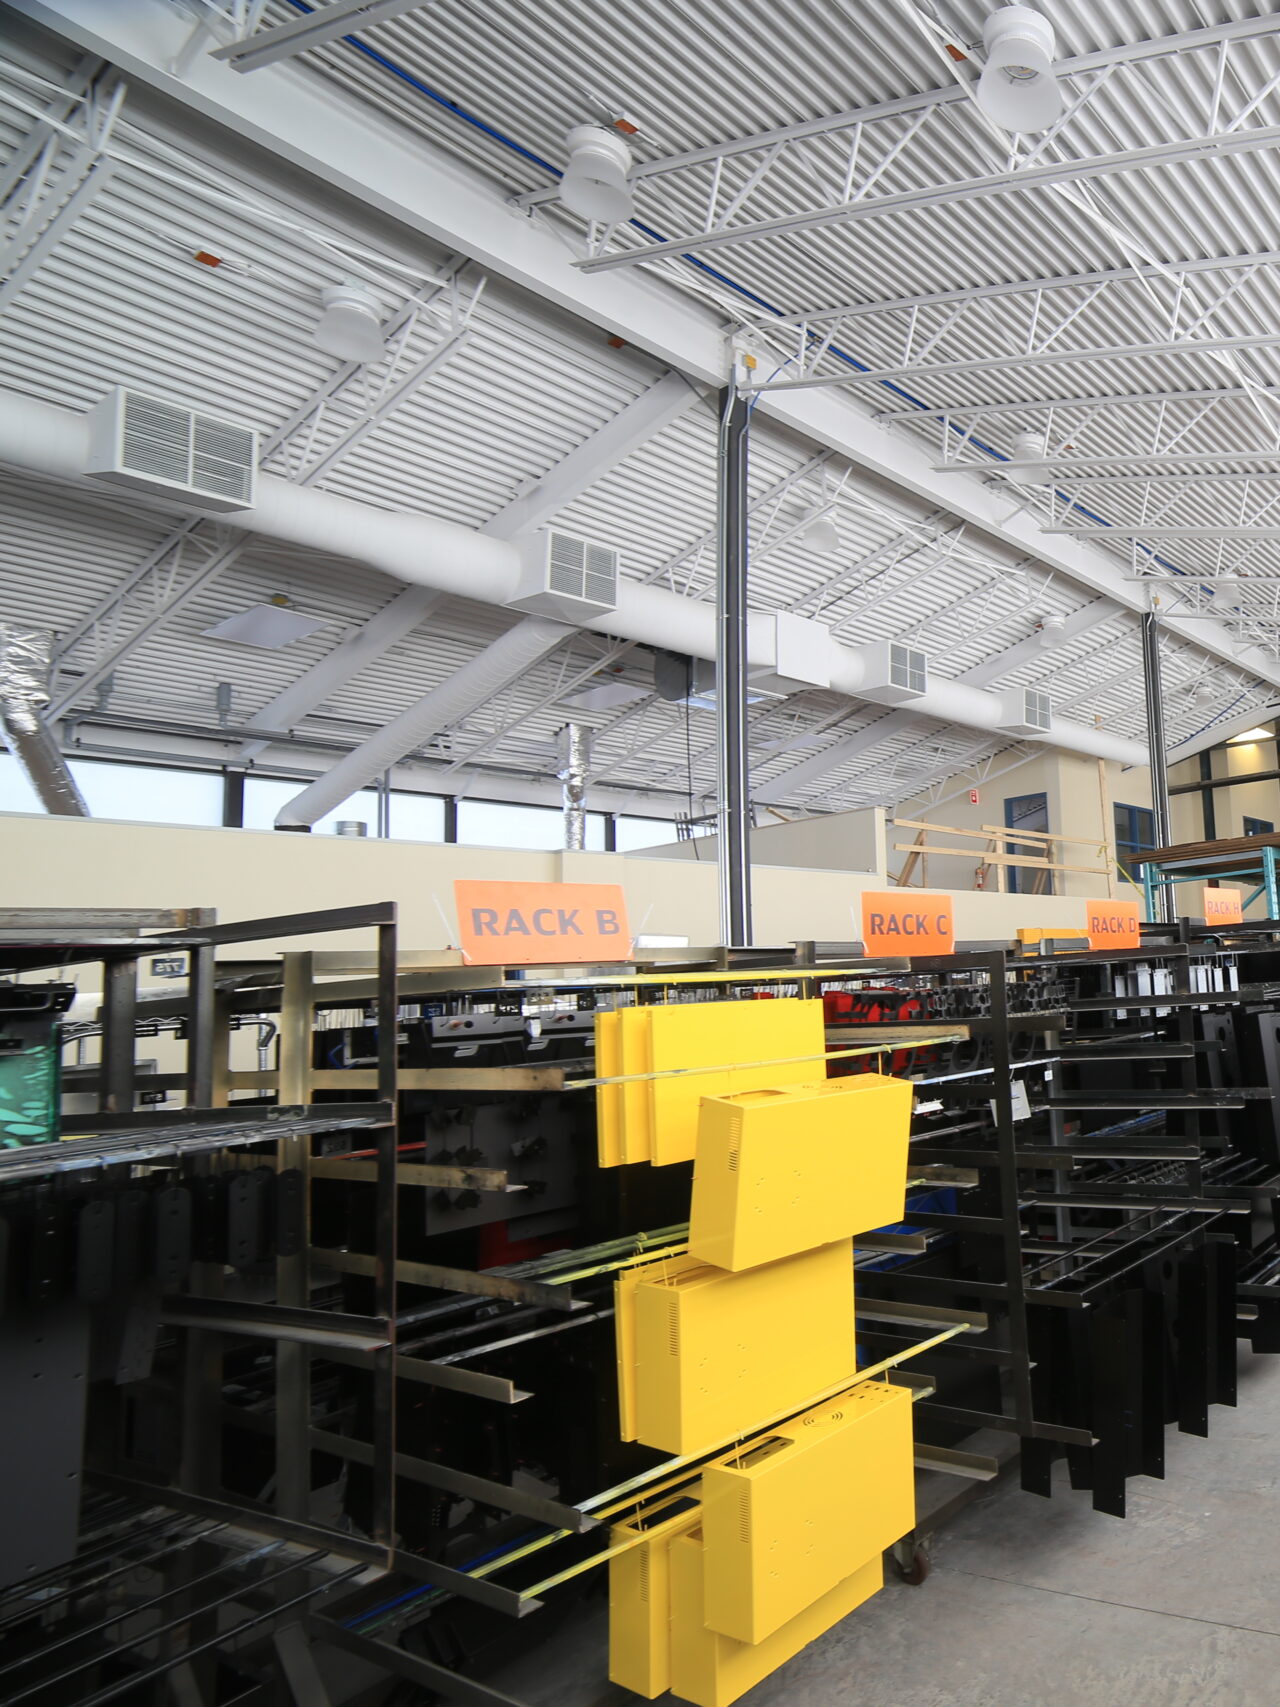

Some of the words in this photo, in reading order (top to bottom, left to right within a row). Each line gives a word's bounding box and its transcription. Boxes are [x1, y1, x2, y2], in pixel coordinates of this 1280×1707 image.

[1207, 901, 1231, 914] RACK
[1233, 901, 1240, 914] H
[471, 908, 584, 936] RACK
[595, 909, 620, 936] B
[870, 913, 928, 936] RACK
[936, 914, 948, 935] C
[1091, 916, 1125, 934] RACK
[1128, 917, 1136, 933] D
